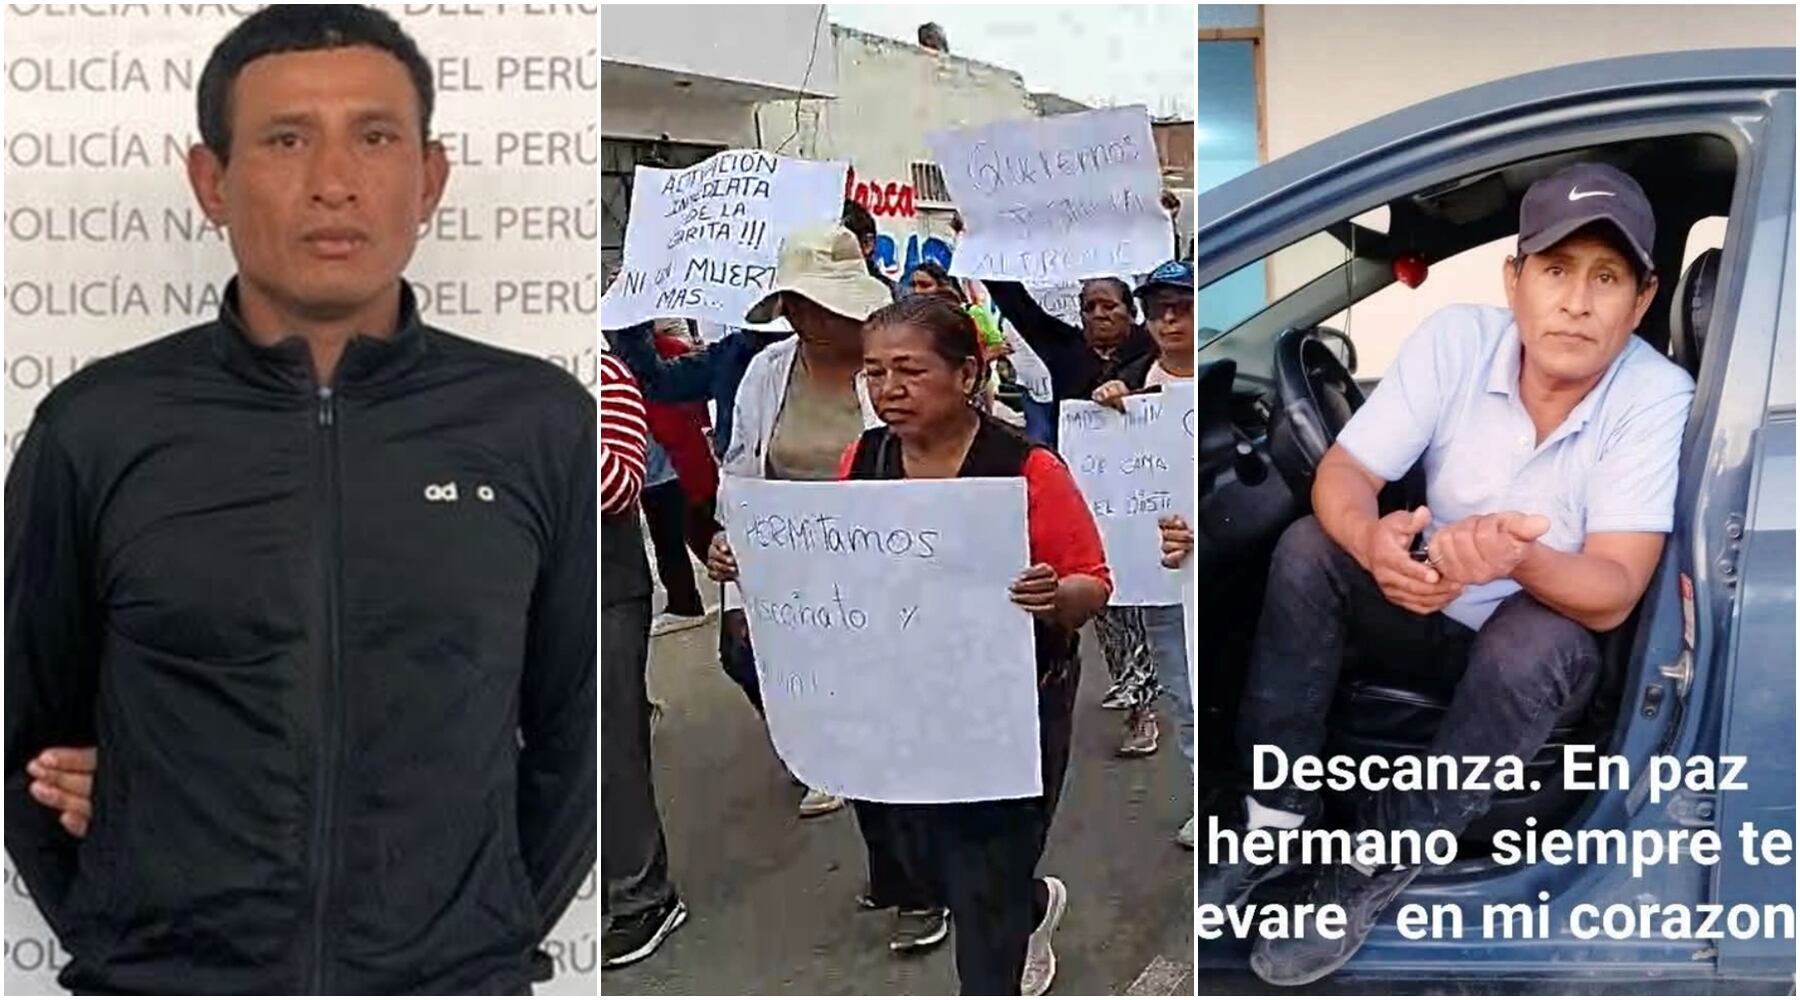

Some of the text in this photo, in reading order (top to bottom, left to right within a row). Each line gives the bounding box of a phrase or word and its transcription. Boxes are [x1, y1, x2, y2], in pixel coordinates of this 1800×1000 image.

[4, 51, 150, 92] OLICÍA
[438, 57, 484, 91] EL
[497, 49, 597, 91] PERÚ
[4, 125, 150, 168] OLICÍA
[438, 132, 483, 166] EL
[497, 124, 597, 166] PERÚ
[4, 201, 150, 242] OLICÍA
[496, 198, 597, 241] PERÚ
[721, 202, 746, 217] LA
[4, 275, 150, 316] OLICÍA
[495, 273, 597, 315] PERÚ
[624, 271, 647, 296] NI
[684, 258, 776, 290] MUERT
